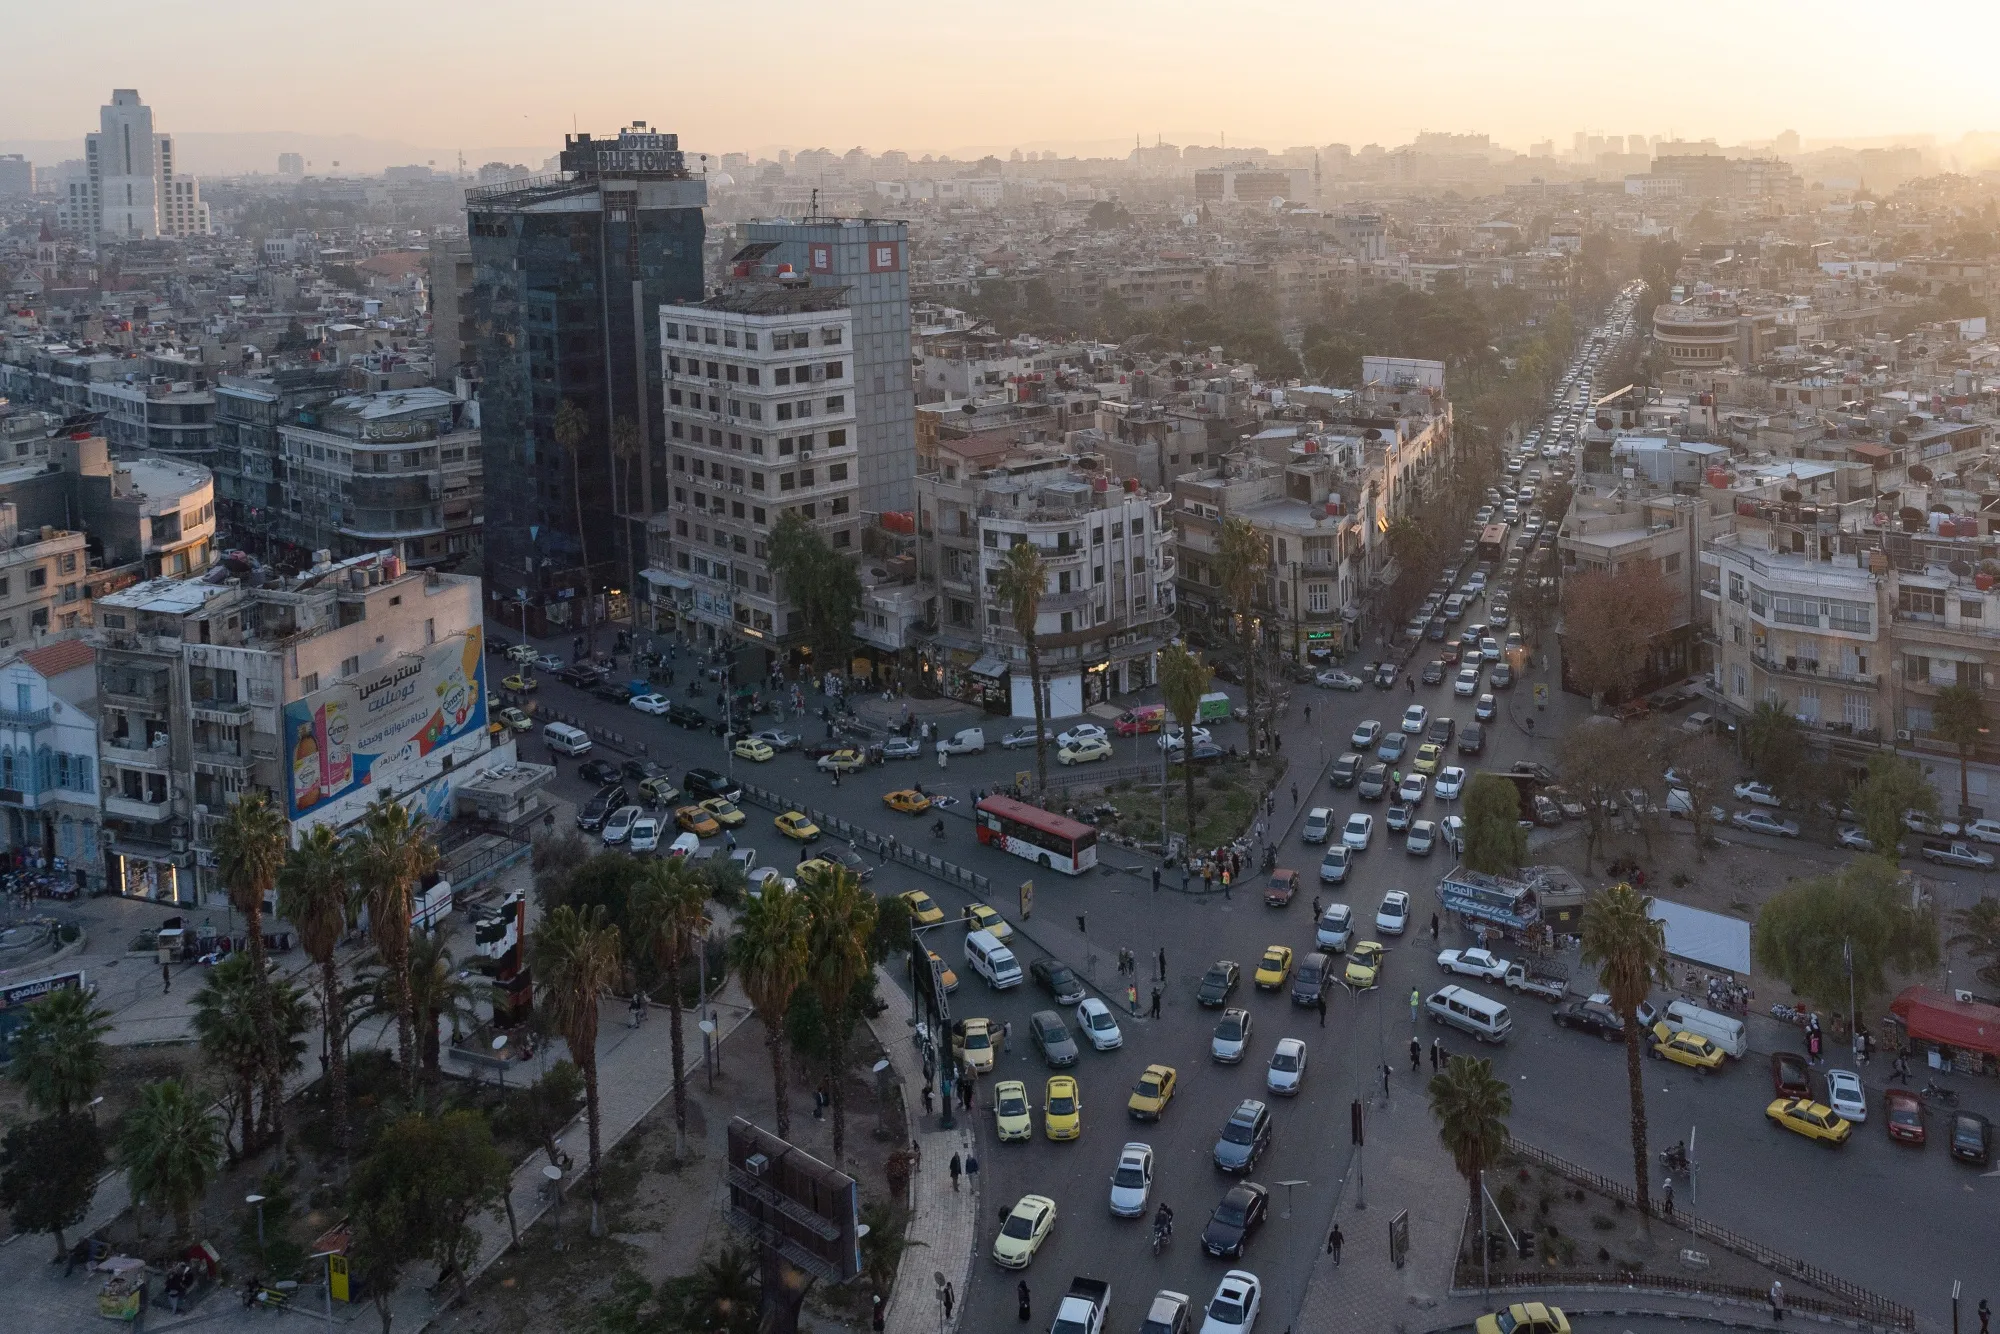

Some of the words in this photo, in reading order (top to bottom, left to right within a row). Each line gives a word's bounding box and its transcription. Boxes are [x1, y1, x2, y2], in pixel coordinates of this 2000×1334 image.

[620, 134, 662, 149] HOTEL
[599, 151, 634, 170] BLUE
[635, 151, 684, 170] TOWER
[359, 662, 422, 701] سنتركس
[368, 680, 416, 713] كومبليت
[410, 708, 429, 723] لحياة
[384, 718, 410, 737] متوازنة
[358, 732, 383, 749] وصحية
